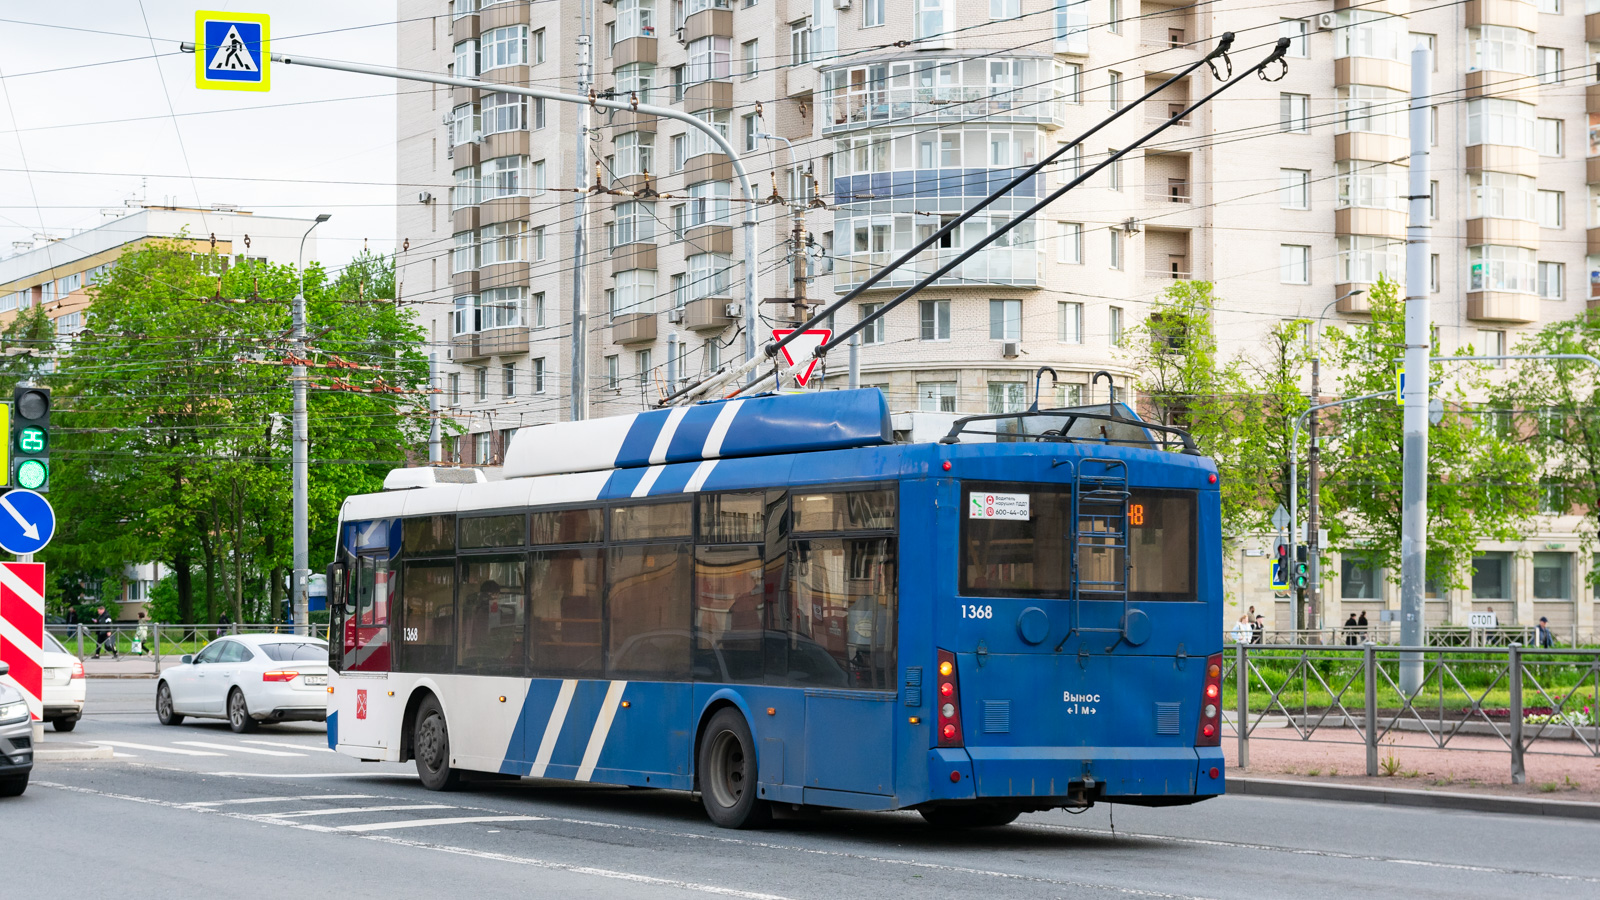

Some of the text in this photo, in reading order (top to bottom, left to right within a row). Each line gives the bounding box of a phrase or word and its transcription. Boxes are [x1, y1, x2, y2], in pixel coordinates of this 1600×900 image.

[22, 430, 43, 450] 25
[961, 604, 993, 619] 1368
[1471, 614, 1492, 625] СТОП
[403, 627, 418, 642] 1368
[1063, 691, 1100, 702] Вынос
